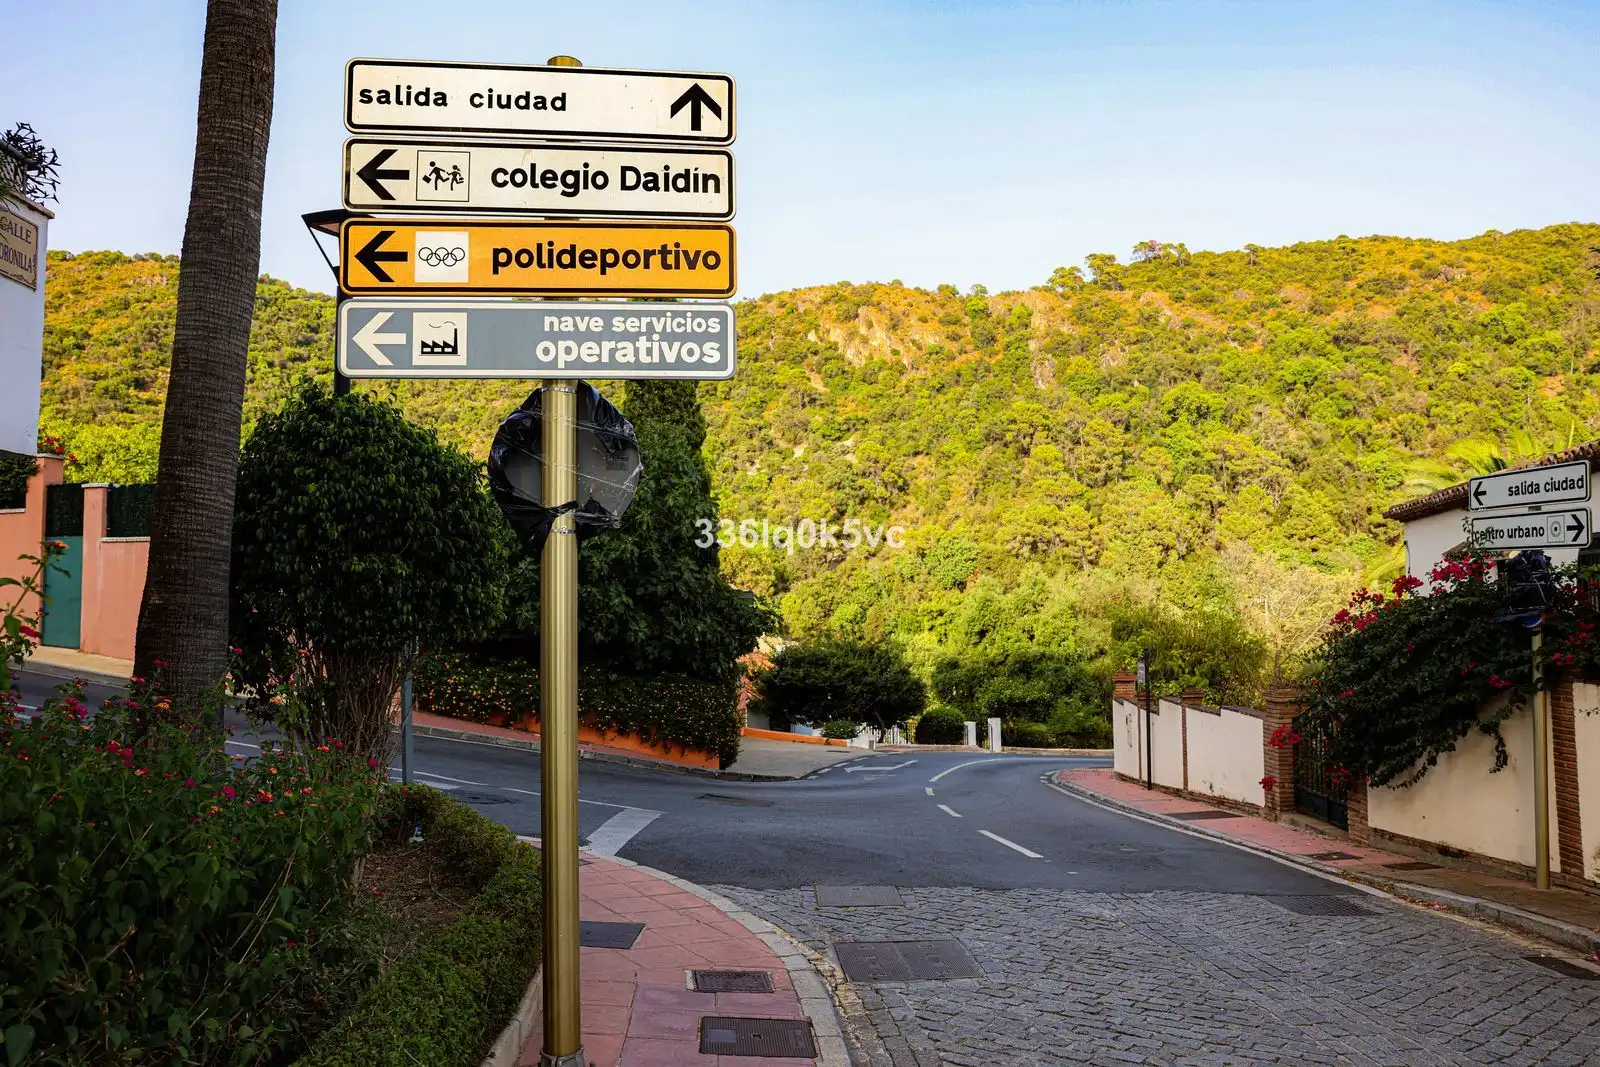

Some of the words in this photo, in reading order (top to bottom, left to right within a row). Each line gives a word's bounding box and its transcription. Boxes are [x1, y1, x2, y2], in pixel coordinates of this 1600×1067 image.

[359, 85, 448, 107] salida
[469, 88, 567, 112] ciudad
[490, 163, 609, 197] colegio
[620, 165, 721, 194] Daidín
[0, 216, 32, 245] CALLE
[492, 240, 721, 275] polideportivo
[543, 315, 604, 333] nave
[612, 311, 721, 334] servicios
[535, 334, 721, 369] operativos
[1507, 480, 1541, 497] salida
[1543, 475, 1585, 493] ciudad
[1507, 525, 1545, 539] urbano
